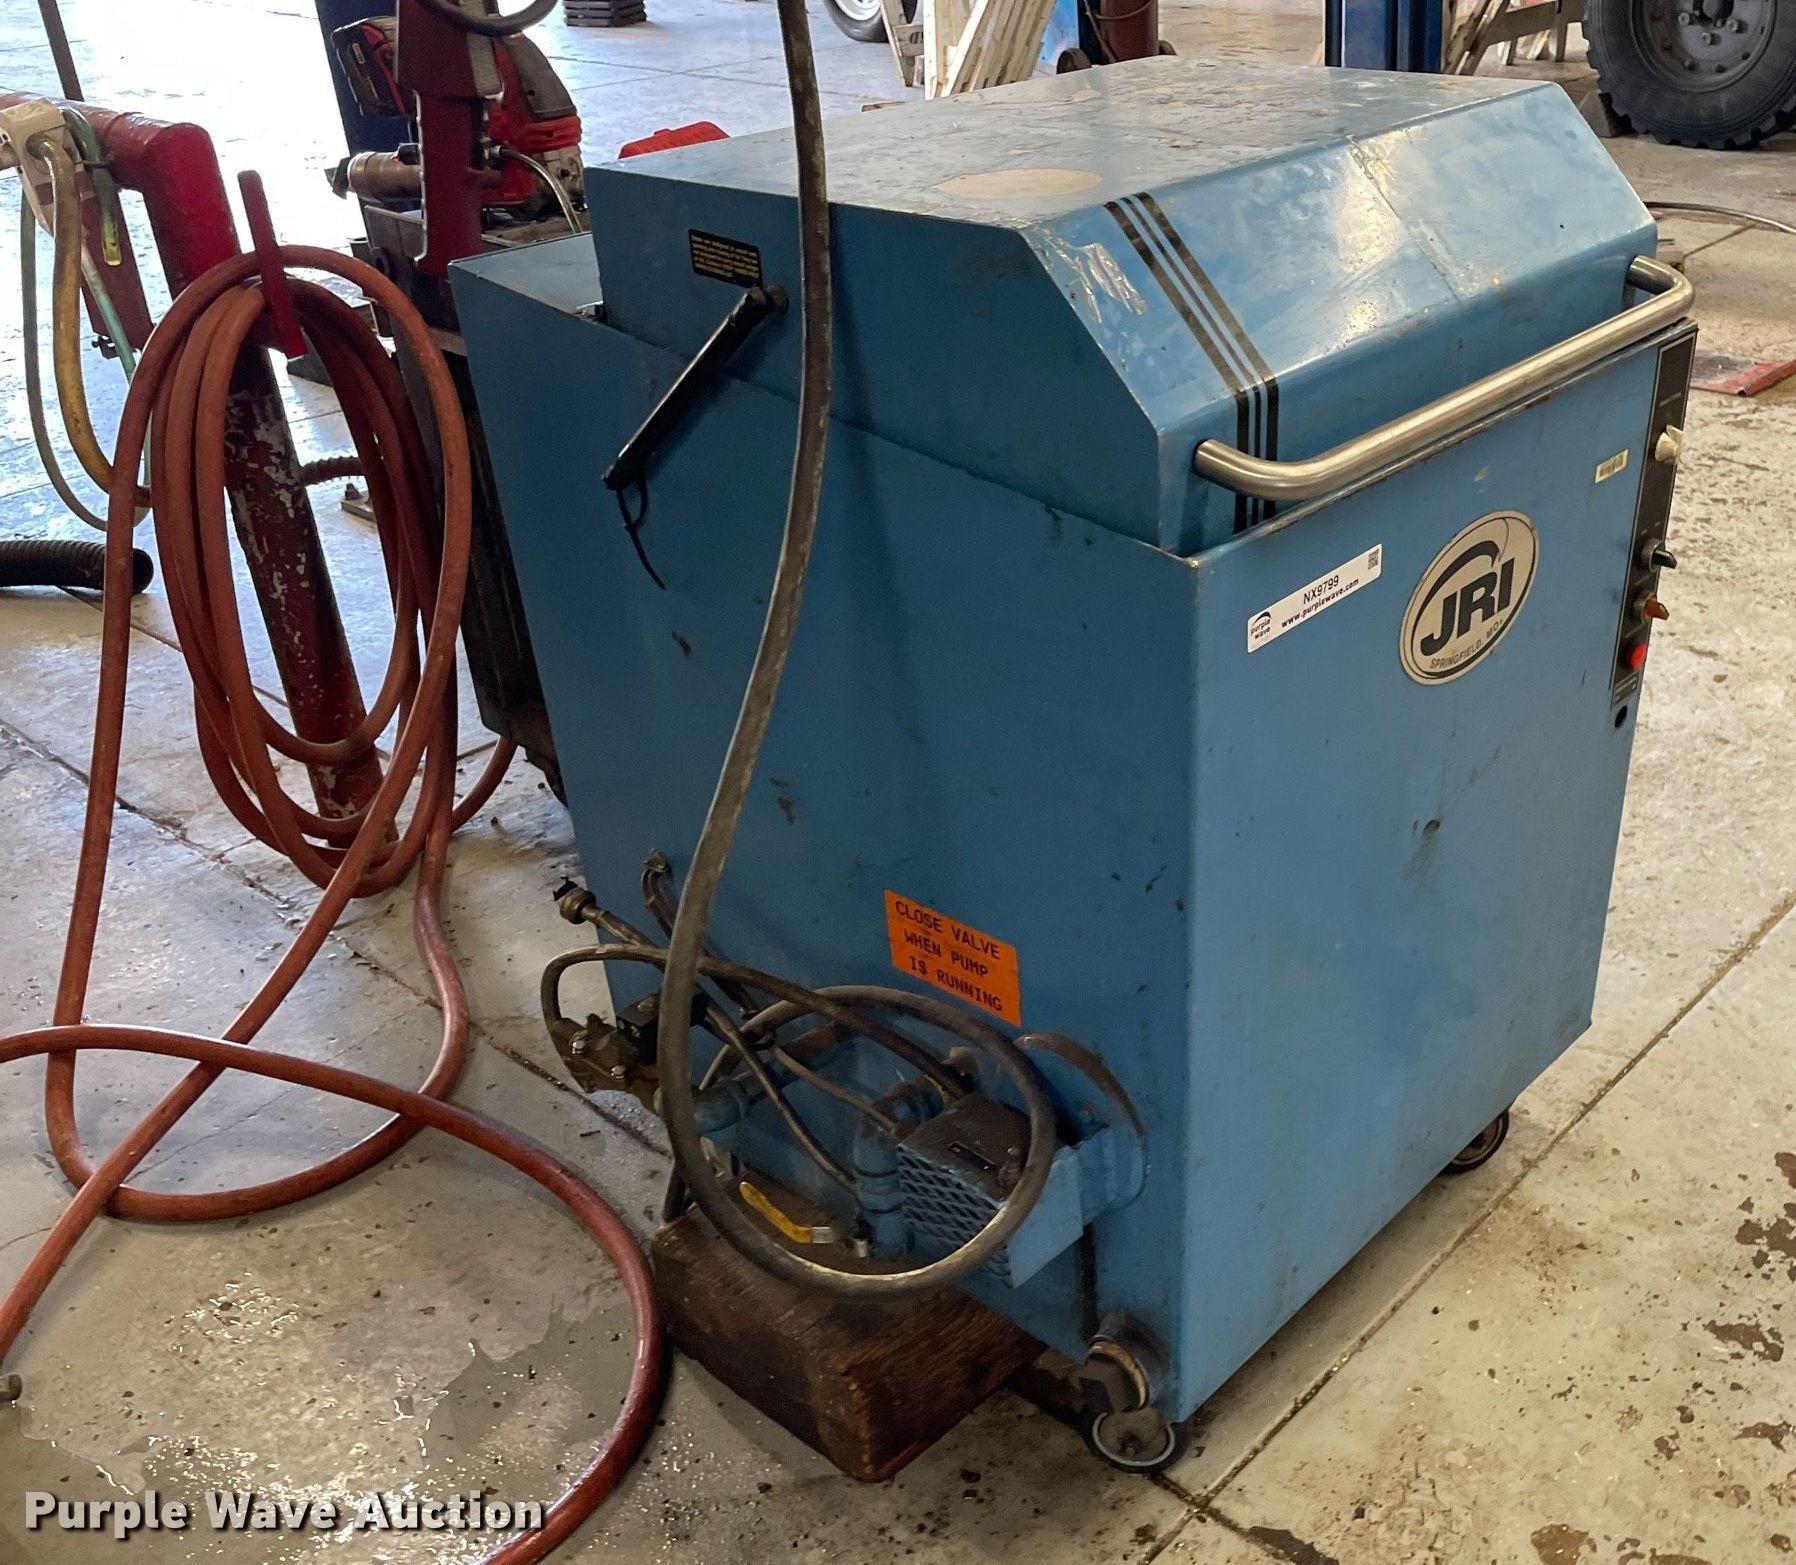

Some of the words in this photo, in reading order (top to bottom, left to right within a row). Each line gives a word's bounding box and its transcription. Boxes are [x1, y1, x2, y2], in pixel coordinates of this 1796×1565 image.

[1281, 578, 1359, 628] www.purplewave.com
[1303, 574, 1339, 604] NX9799
[1420, 557, 1515, 657] JRI
[1250, 618, 1270, 636] purple
[1254, 626, 1270, 639] wave
[895, 900, 943, 933] CLOSE
[951, 925, 1000, 960] VALVE
[903, 928, 942, 958] WHEN
[950, 950, 989, 978] PUMP
[909, 955, 928, 975] IS
[936, 968, 1003, 1012] RUNNING
